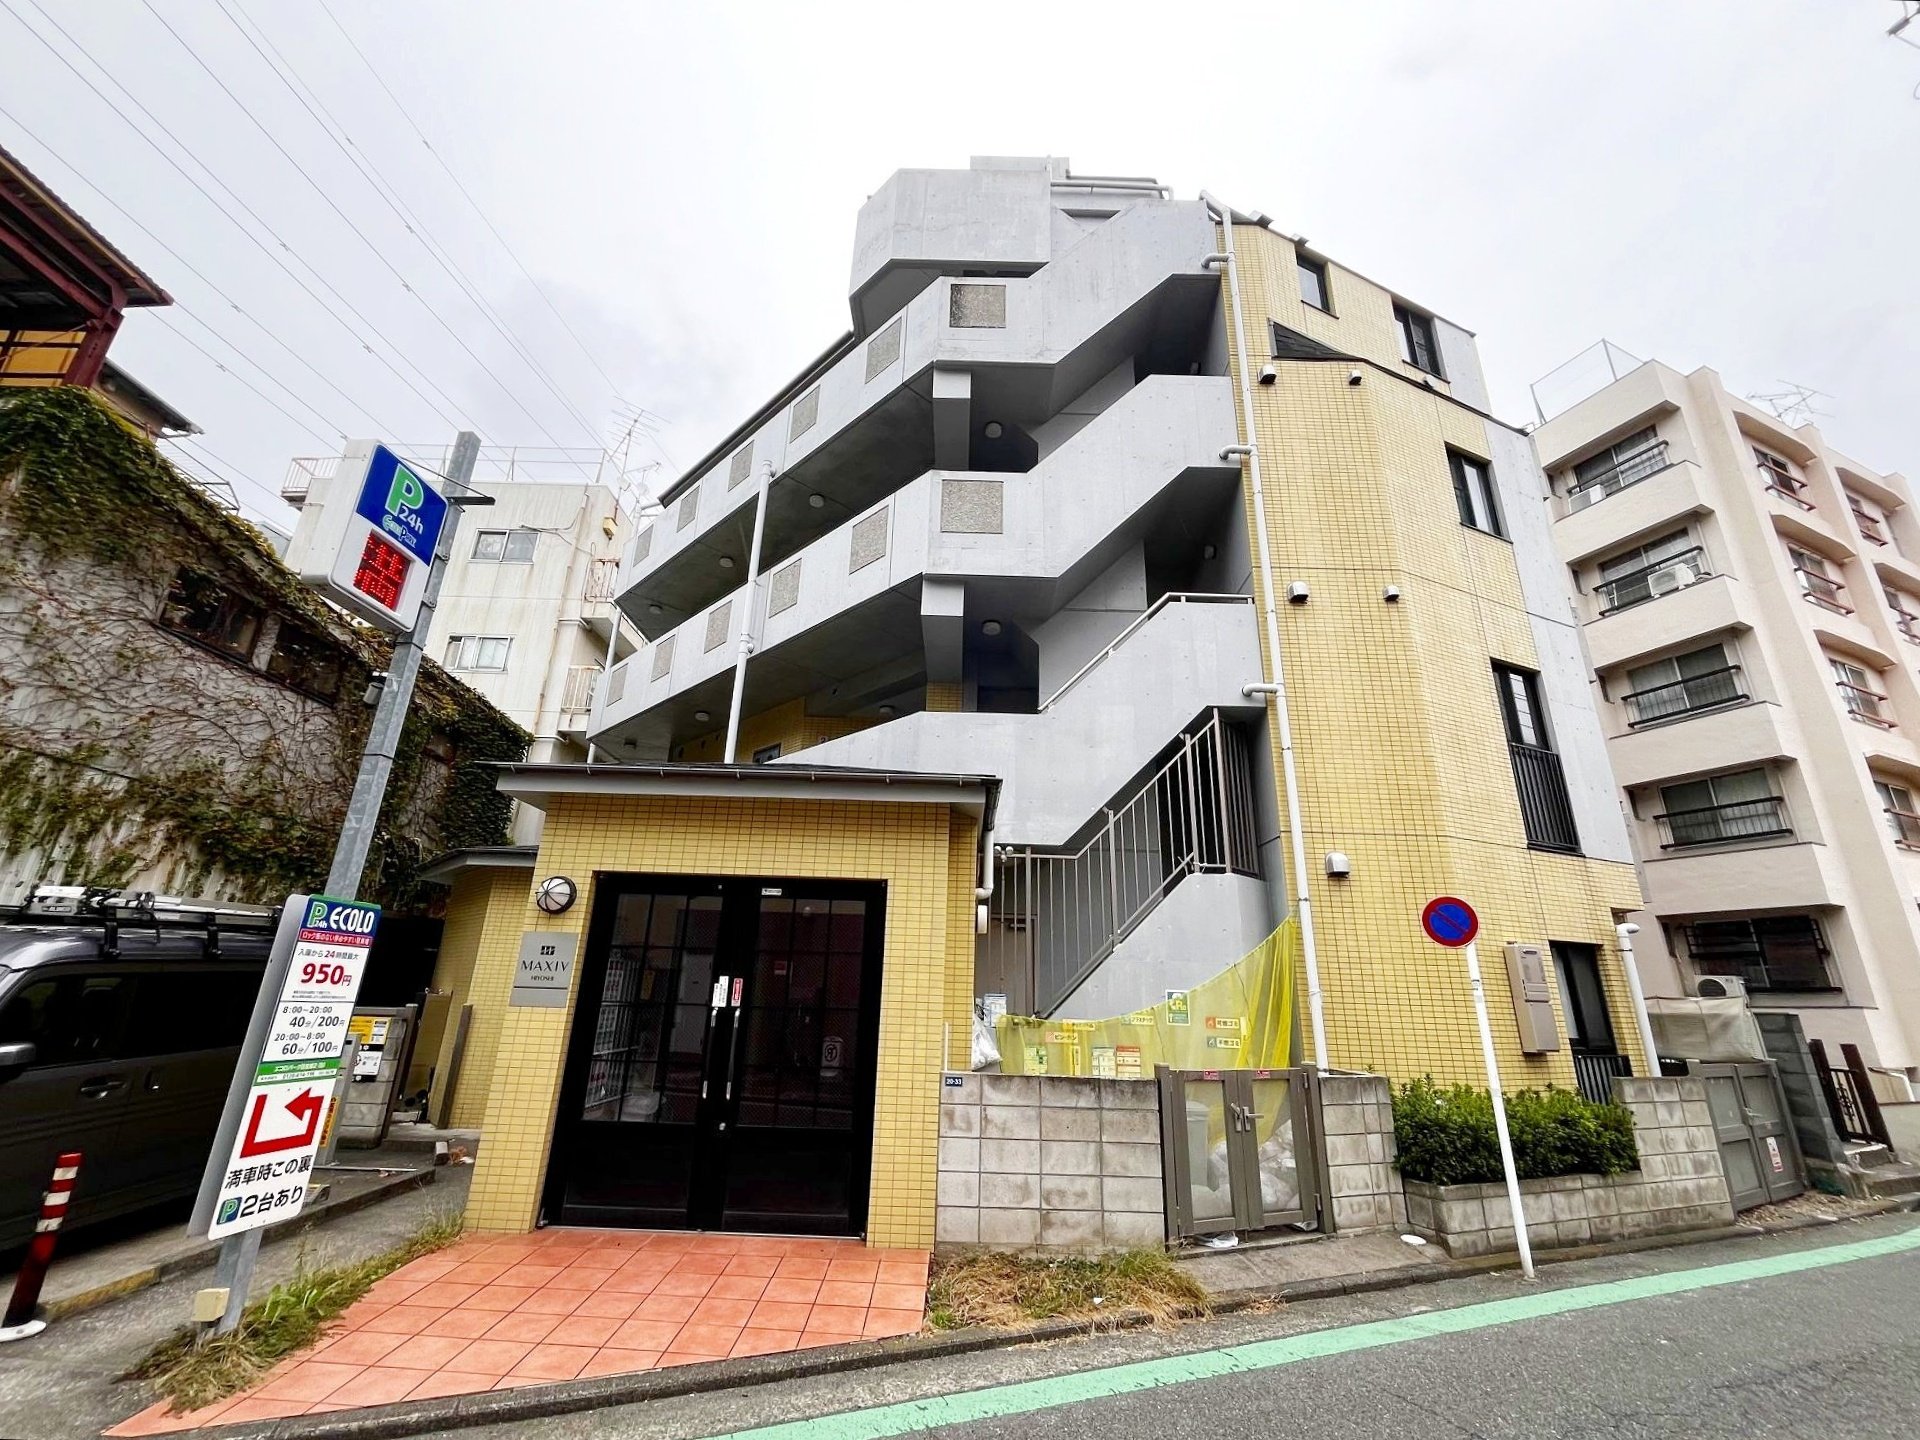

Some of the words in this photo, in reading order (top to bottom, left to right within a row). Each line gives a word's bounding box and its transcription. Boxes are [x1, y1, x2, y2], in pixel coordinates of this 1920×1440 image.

[385, 462, 424, 516] P
[399, 506, 424, 535] 24h
[329, 906, 375, 933] ECOLO
[300, 963, 353, 986] 950円
[520, 960, 570, 972] MAXIV
[225, 1155, 313, 1189] 満車時この裏
[240, 1185, 303, 1219] 2台あり
